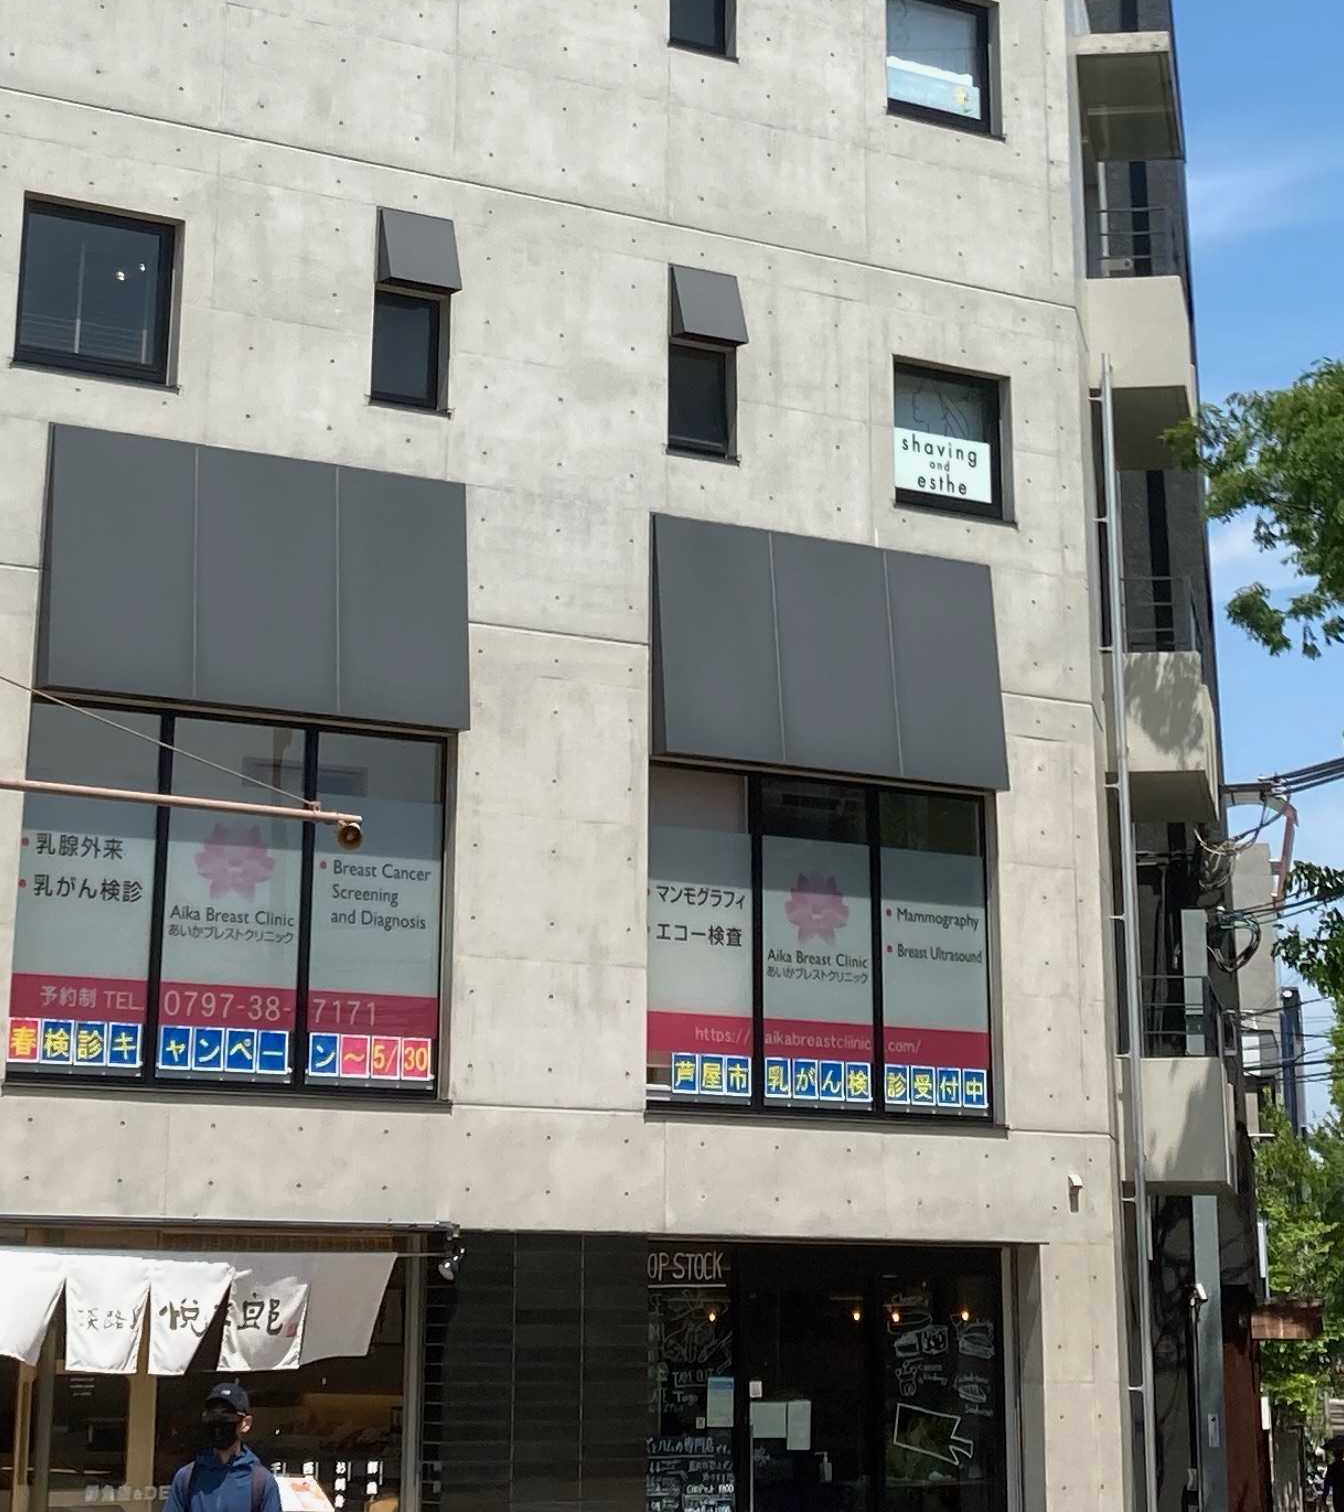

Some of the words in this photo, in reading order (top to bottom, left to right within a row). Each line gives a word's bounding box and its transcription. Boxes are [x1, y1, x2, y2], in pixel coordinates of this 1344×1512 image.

[901, 433, 977, 468] shaving
[929, 460, 950, 472] and
[917, 474, 967, 495] esthe
[35, 832, 124, 860] 乳腺外来
[333, 859, 378, 878] Breast
[381, 864, 431, 882] Cancer
[32, 873, 143, 903] 乳がん検診
[331, 884, 399, 907] Screening
[656, 885, 745, 910] マンモグラフィ
[169, 905, 202, 922] Aika
[206, 906, 251, 925] Breast
[254, 909, 295, 927] Clinic
[330, 909, 356, 926] and
[360, 911, 427, 931] Diagnosis
[897, 907, 979, 930] Mammography
[167, 924, 295, 945] あいかブレストクリニック
[656, 924, 743, 948] エコー検査
[767, 949, 792, 964] Aika
[796, 950, 832, 967] Breast
[835, 953, 868, 969] Clinic
[897, 944, 928, 960] Breast
[930, 947, 983, 965] Ultrasound
[766, 966, 869, 984] あいかブレストクリニック
[39, 985, 97, 1009] 予約制
[672, 1250, 724, 1281] STOCK
